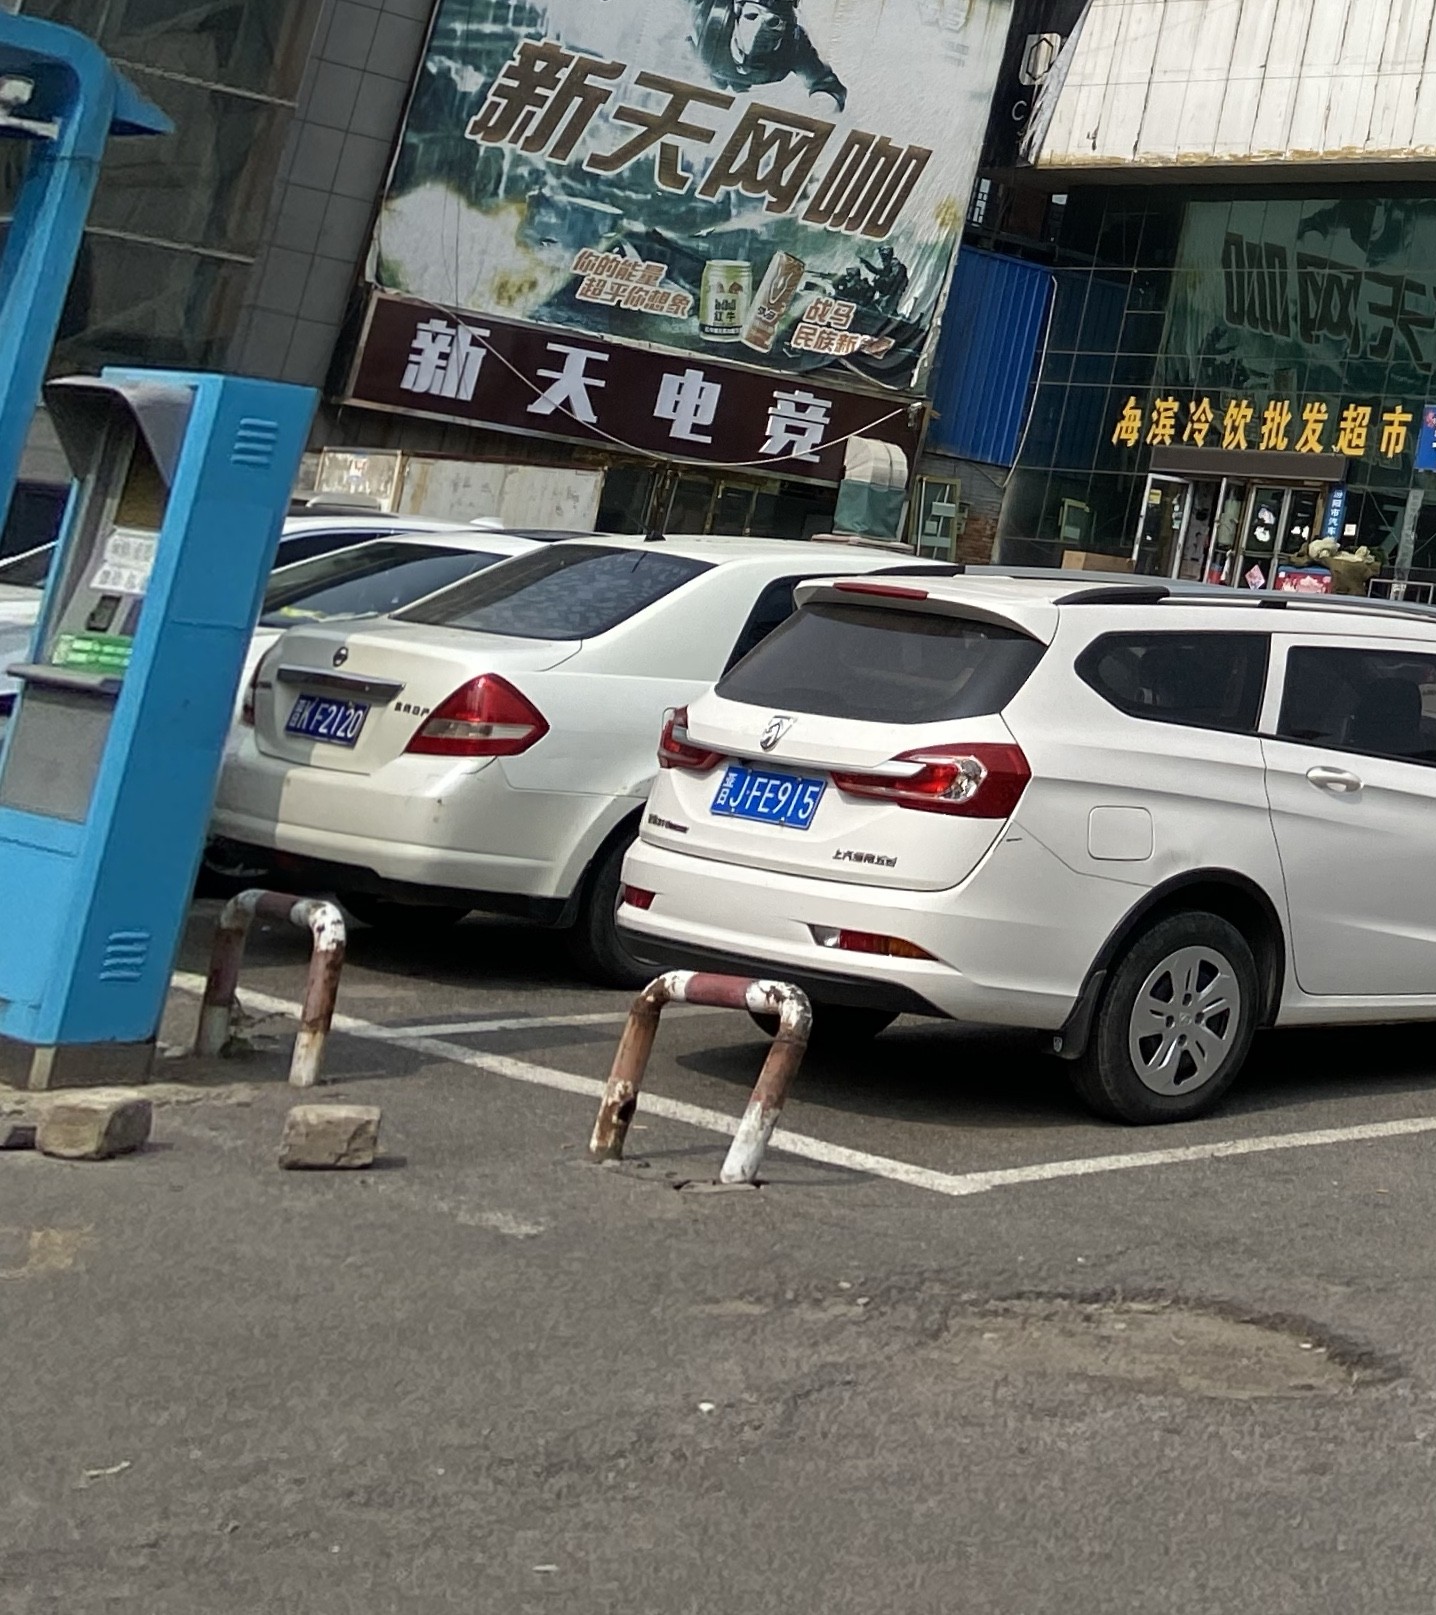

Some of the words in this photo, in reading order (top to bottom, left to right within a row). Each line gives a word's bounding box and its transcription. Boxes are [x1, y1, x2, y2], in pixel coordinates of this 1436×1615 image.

[465, 39, 934, 241] 新天网咖
[573, 249, 668, 287] 你的能量
[577, 277, 693, 319] 超乎你想象
[803, 297, 855, 330] 战马
[400, 318, 832, 464] 新天电竞
[1110, 395, 1415, 458] 海滨冷饮批发超市
